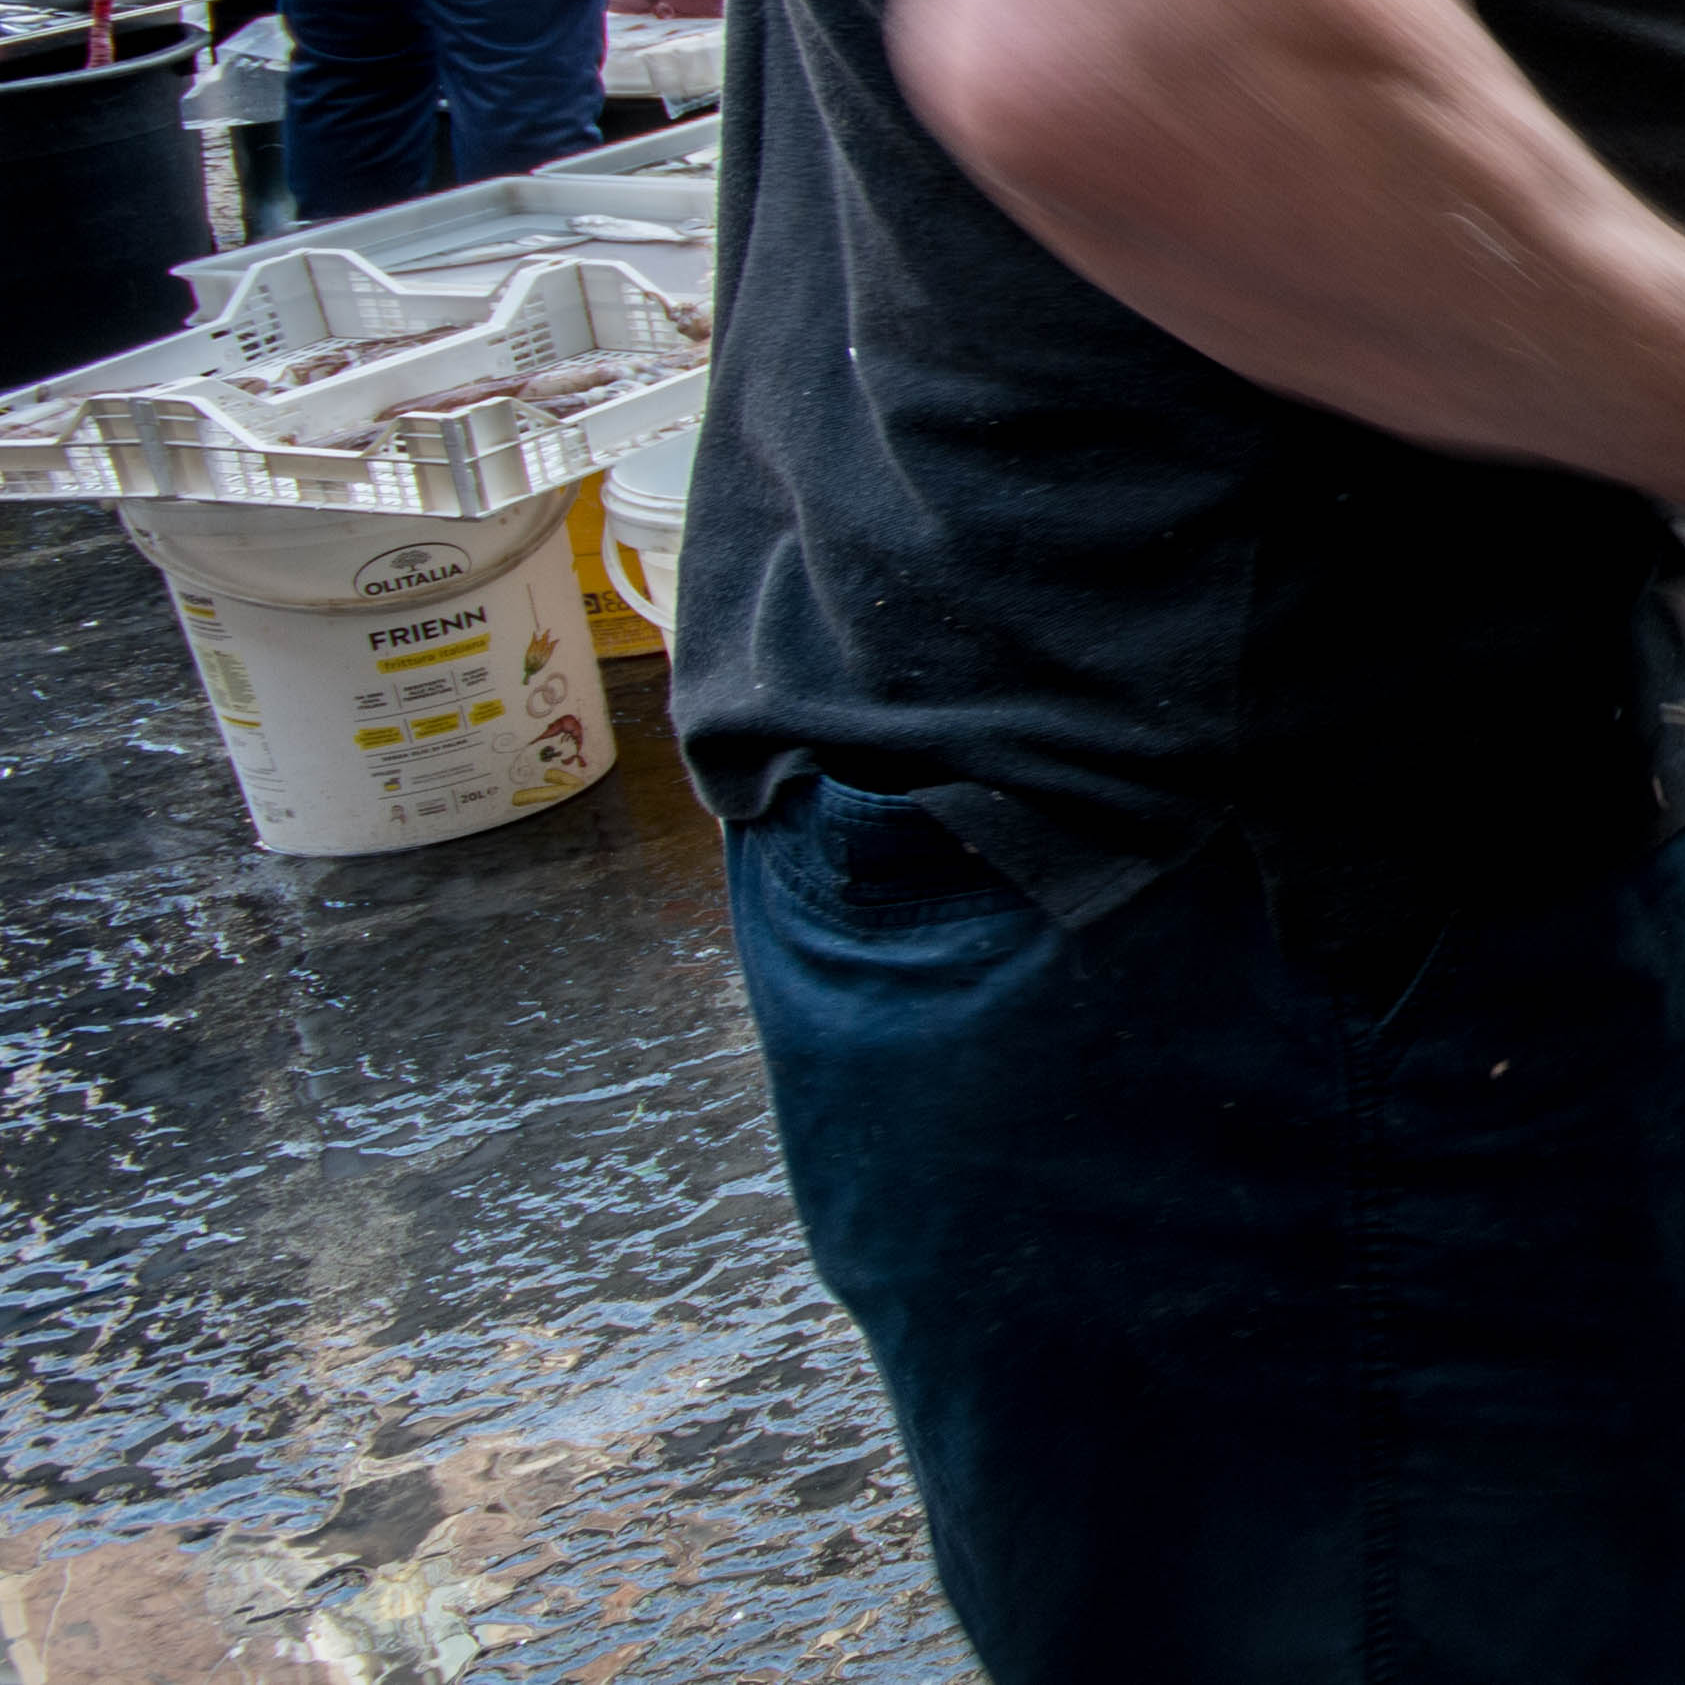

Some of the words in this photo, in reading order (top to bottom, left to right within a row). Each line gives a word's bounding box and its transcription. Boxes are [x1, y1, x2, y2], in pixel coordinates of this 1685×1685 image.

[364, 563, 464, 596] OLITALIA
[368, 606, 488, 651] FRIENN
[383, 653, 436, 671] frittura
[438, 639, 487, 658] italiana
[460, 789, 486, 804] 20L
